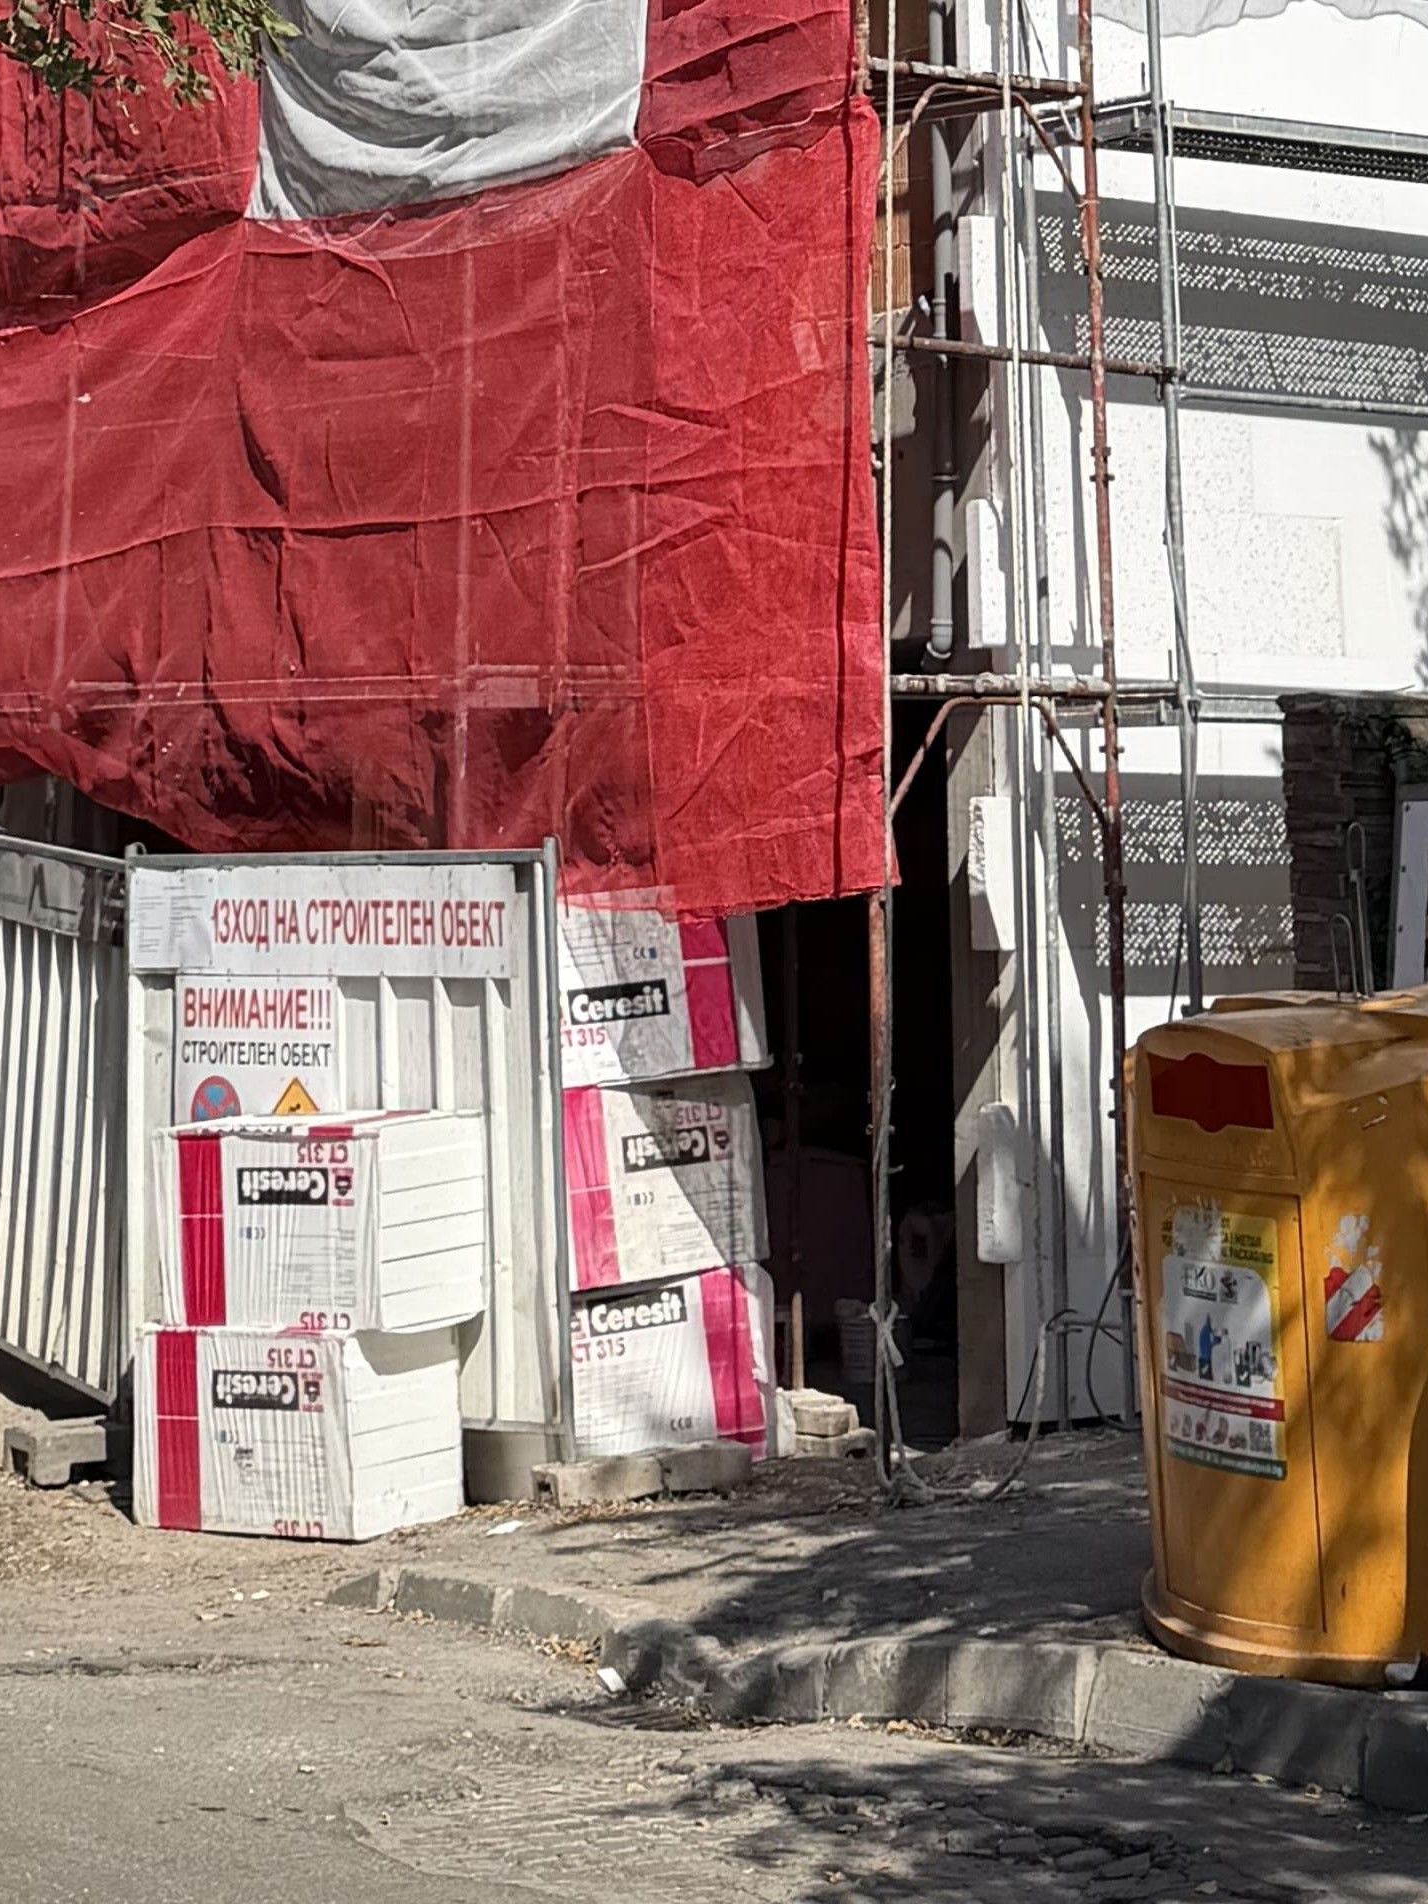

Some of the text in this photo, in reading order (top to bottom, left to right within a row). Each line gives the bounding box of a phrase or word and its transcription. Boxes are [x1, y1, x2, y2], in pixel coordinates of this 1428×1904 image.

[274, 899, 301, 944] НА
[305, 898, 436, 946] СТРОИТЕЛЕН
[440, 900, 505, 948] ОБЕКТ
[183, 988, 332, 1030] ВНИМАНИЕ!!!
[572, 985, 665, 1023] Ceresit
[577, 1026, 607, 1047] 315
[181, 1040, 332, 1068] СТРОИТЕЛЕН ОБЕКТ
[297, 1143, 349, 1164] CT 315
[241, 1170, 326, 1201] Ceresit
[590, 1291, 683, 1334] Ceresit
[266, 1348, 317, 1369] CT 315
[572, 1337, 626, 1364] CT 315
[215, 1373, 296, 1405] Ceresit
